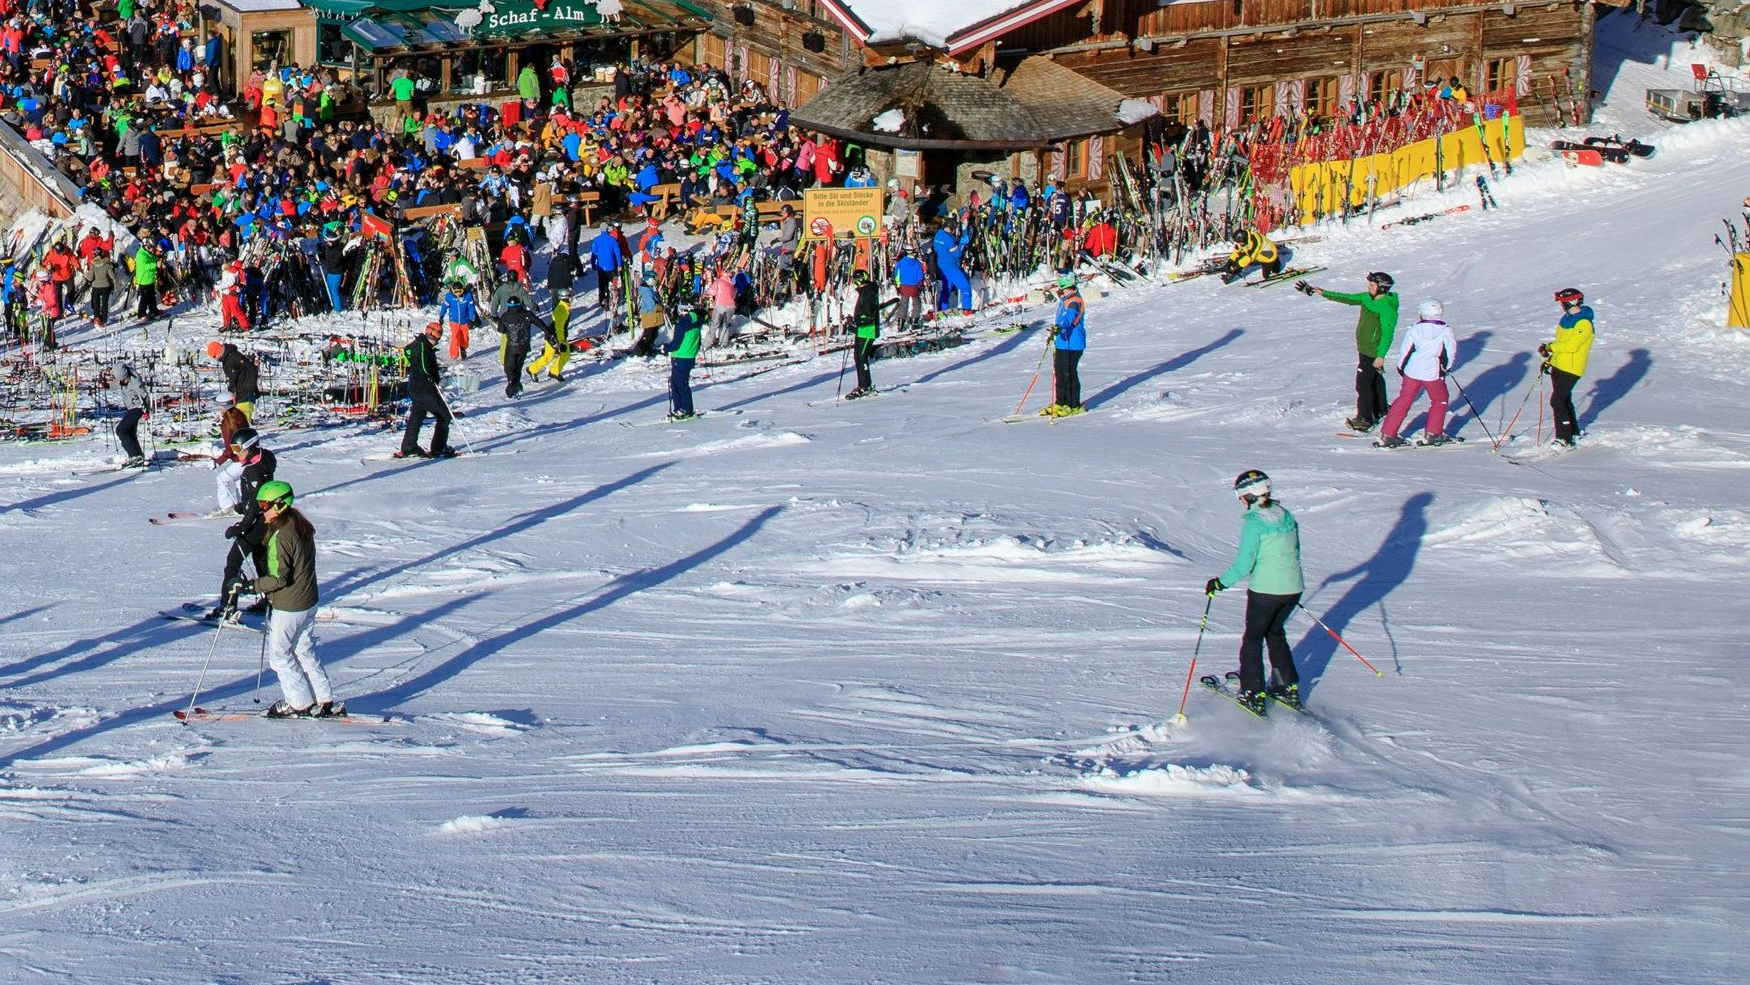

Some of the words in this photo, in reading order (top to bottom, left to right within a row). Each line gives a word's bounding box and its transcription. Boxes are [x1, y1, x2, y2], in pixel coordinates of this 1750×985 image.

[489, 9, 538, 28] Schaf
[553, 6, 584, 21] Alm
[813, 192, 827, 200] Bitte
